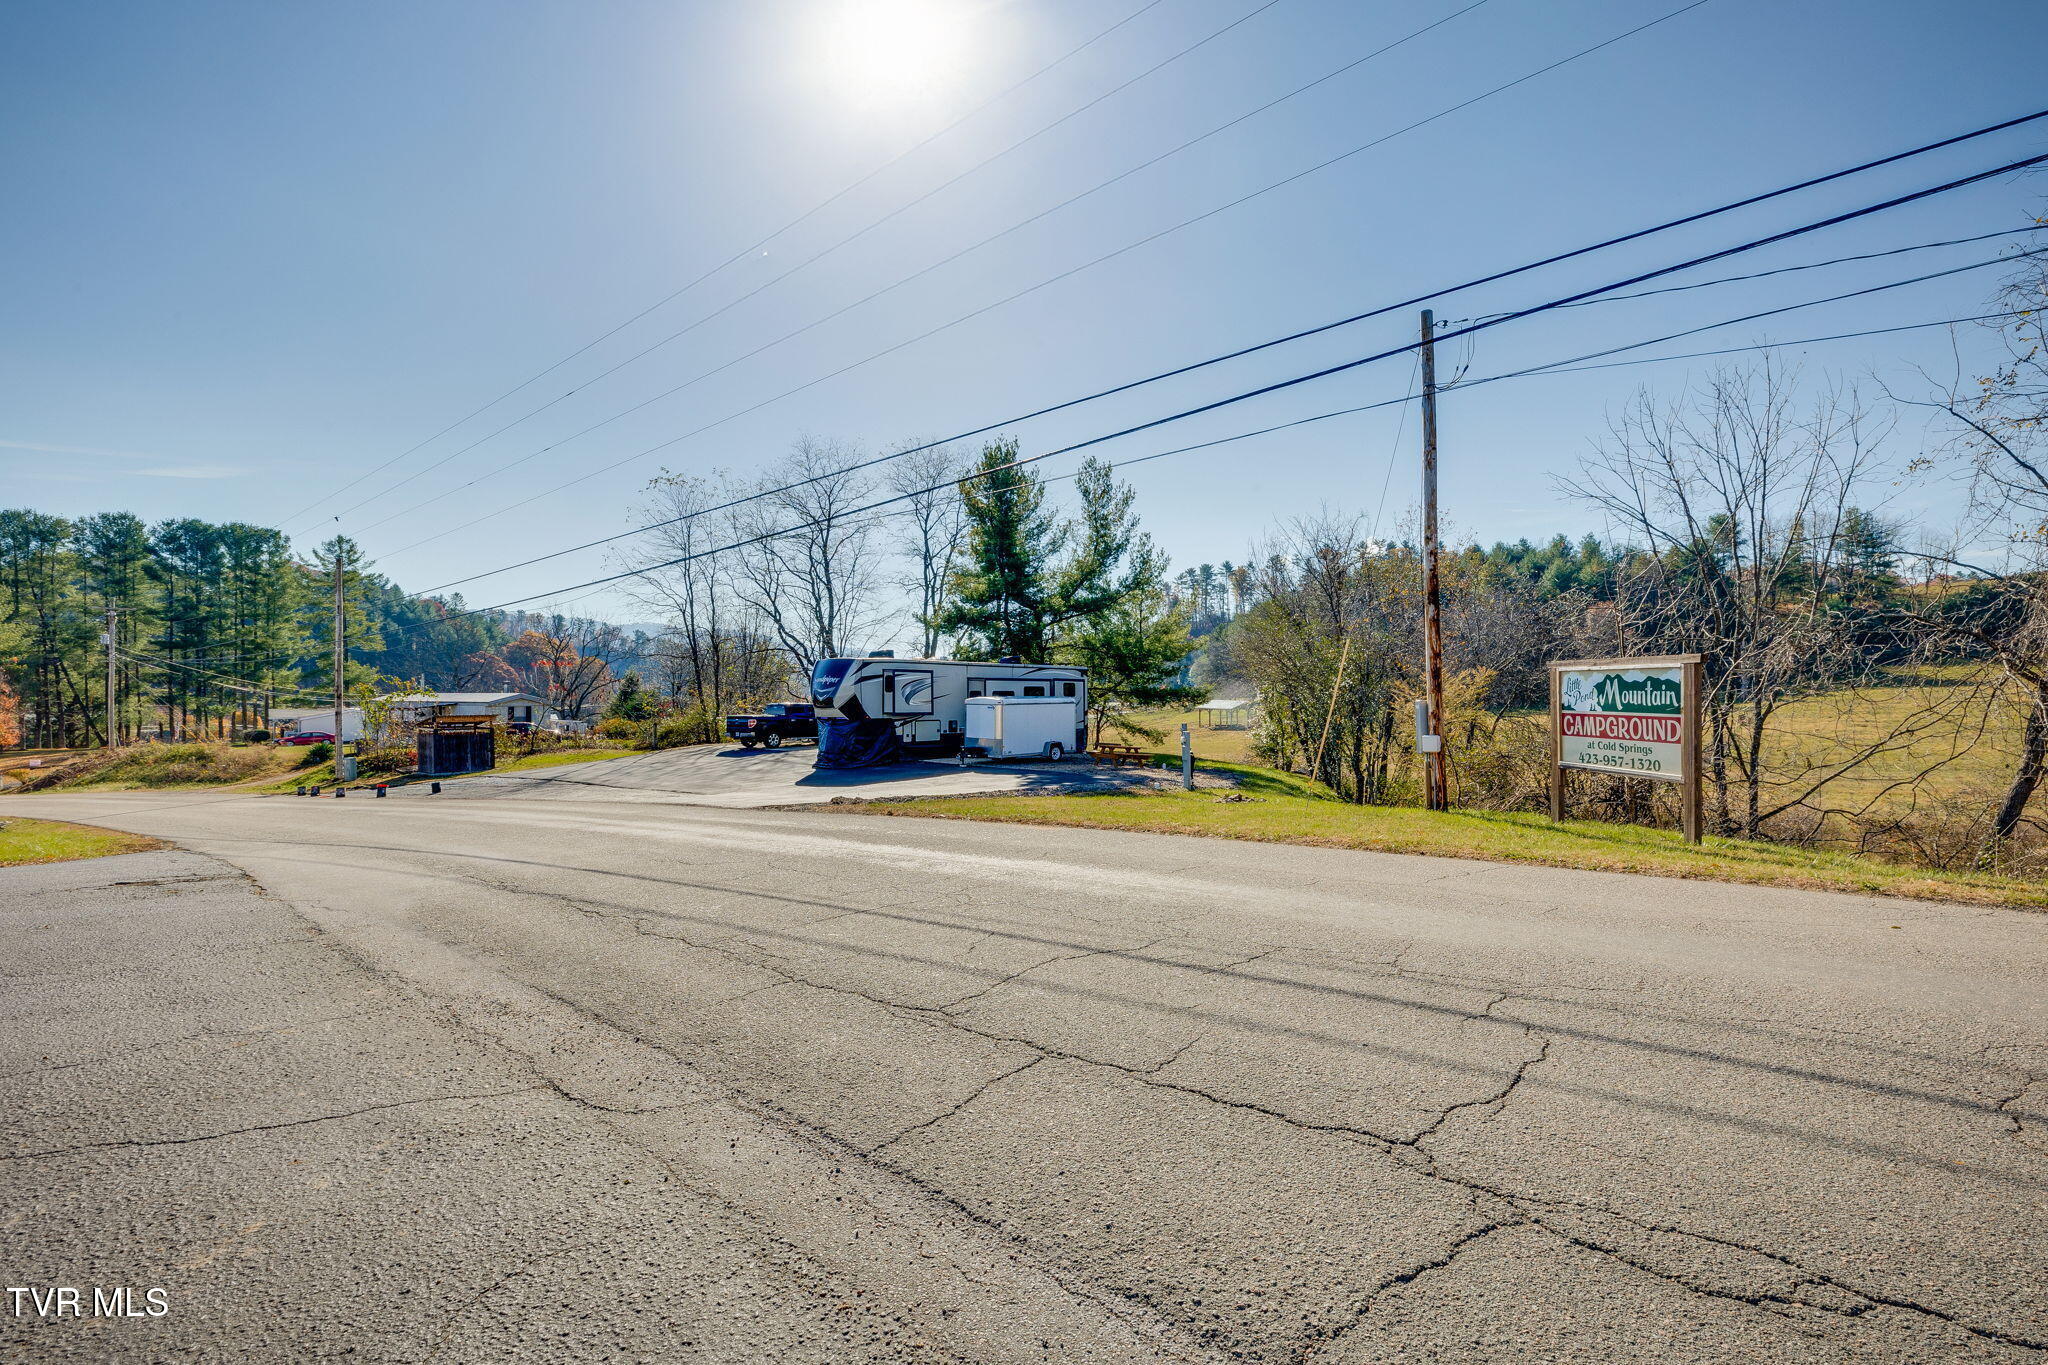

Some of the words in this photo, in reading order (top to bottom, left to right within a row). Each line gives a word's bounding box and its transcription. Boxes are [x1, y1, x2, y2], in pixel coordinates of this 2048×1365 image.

[1564, 677, 1582, 696] Little
[1573, 686, 1595, 706] Pond
[1600, 679, 1679, 710] Mountain
[1564, 716, 1681, 742] CAMPGROUND
[1587, 741, 1596, 749] at
[1597, 741, 1617, 751] Cold
[1618, 744, 1653, 756] Springs
[1578, 752, 1661, 772] 423-957-1320
